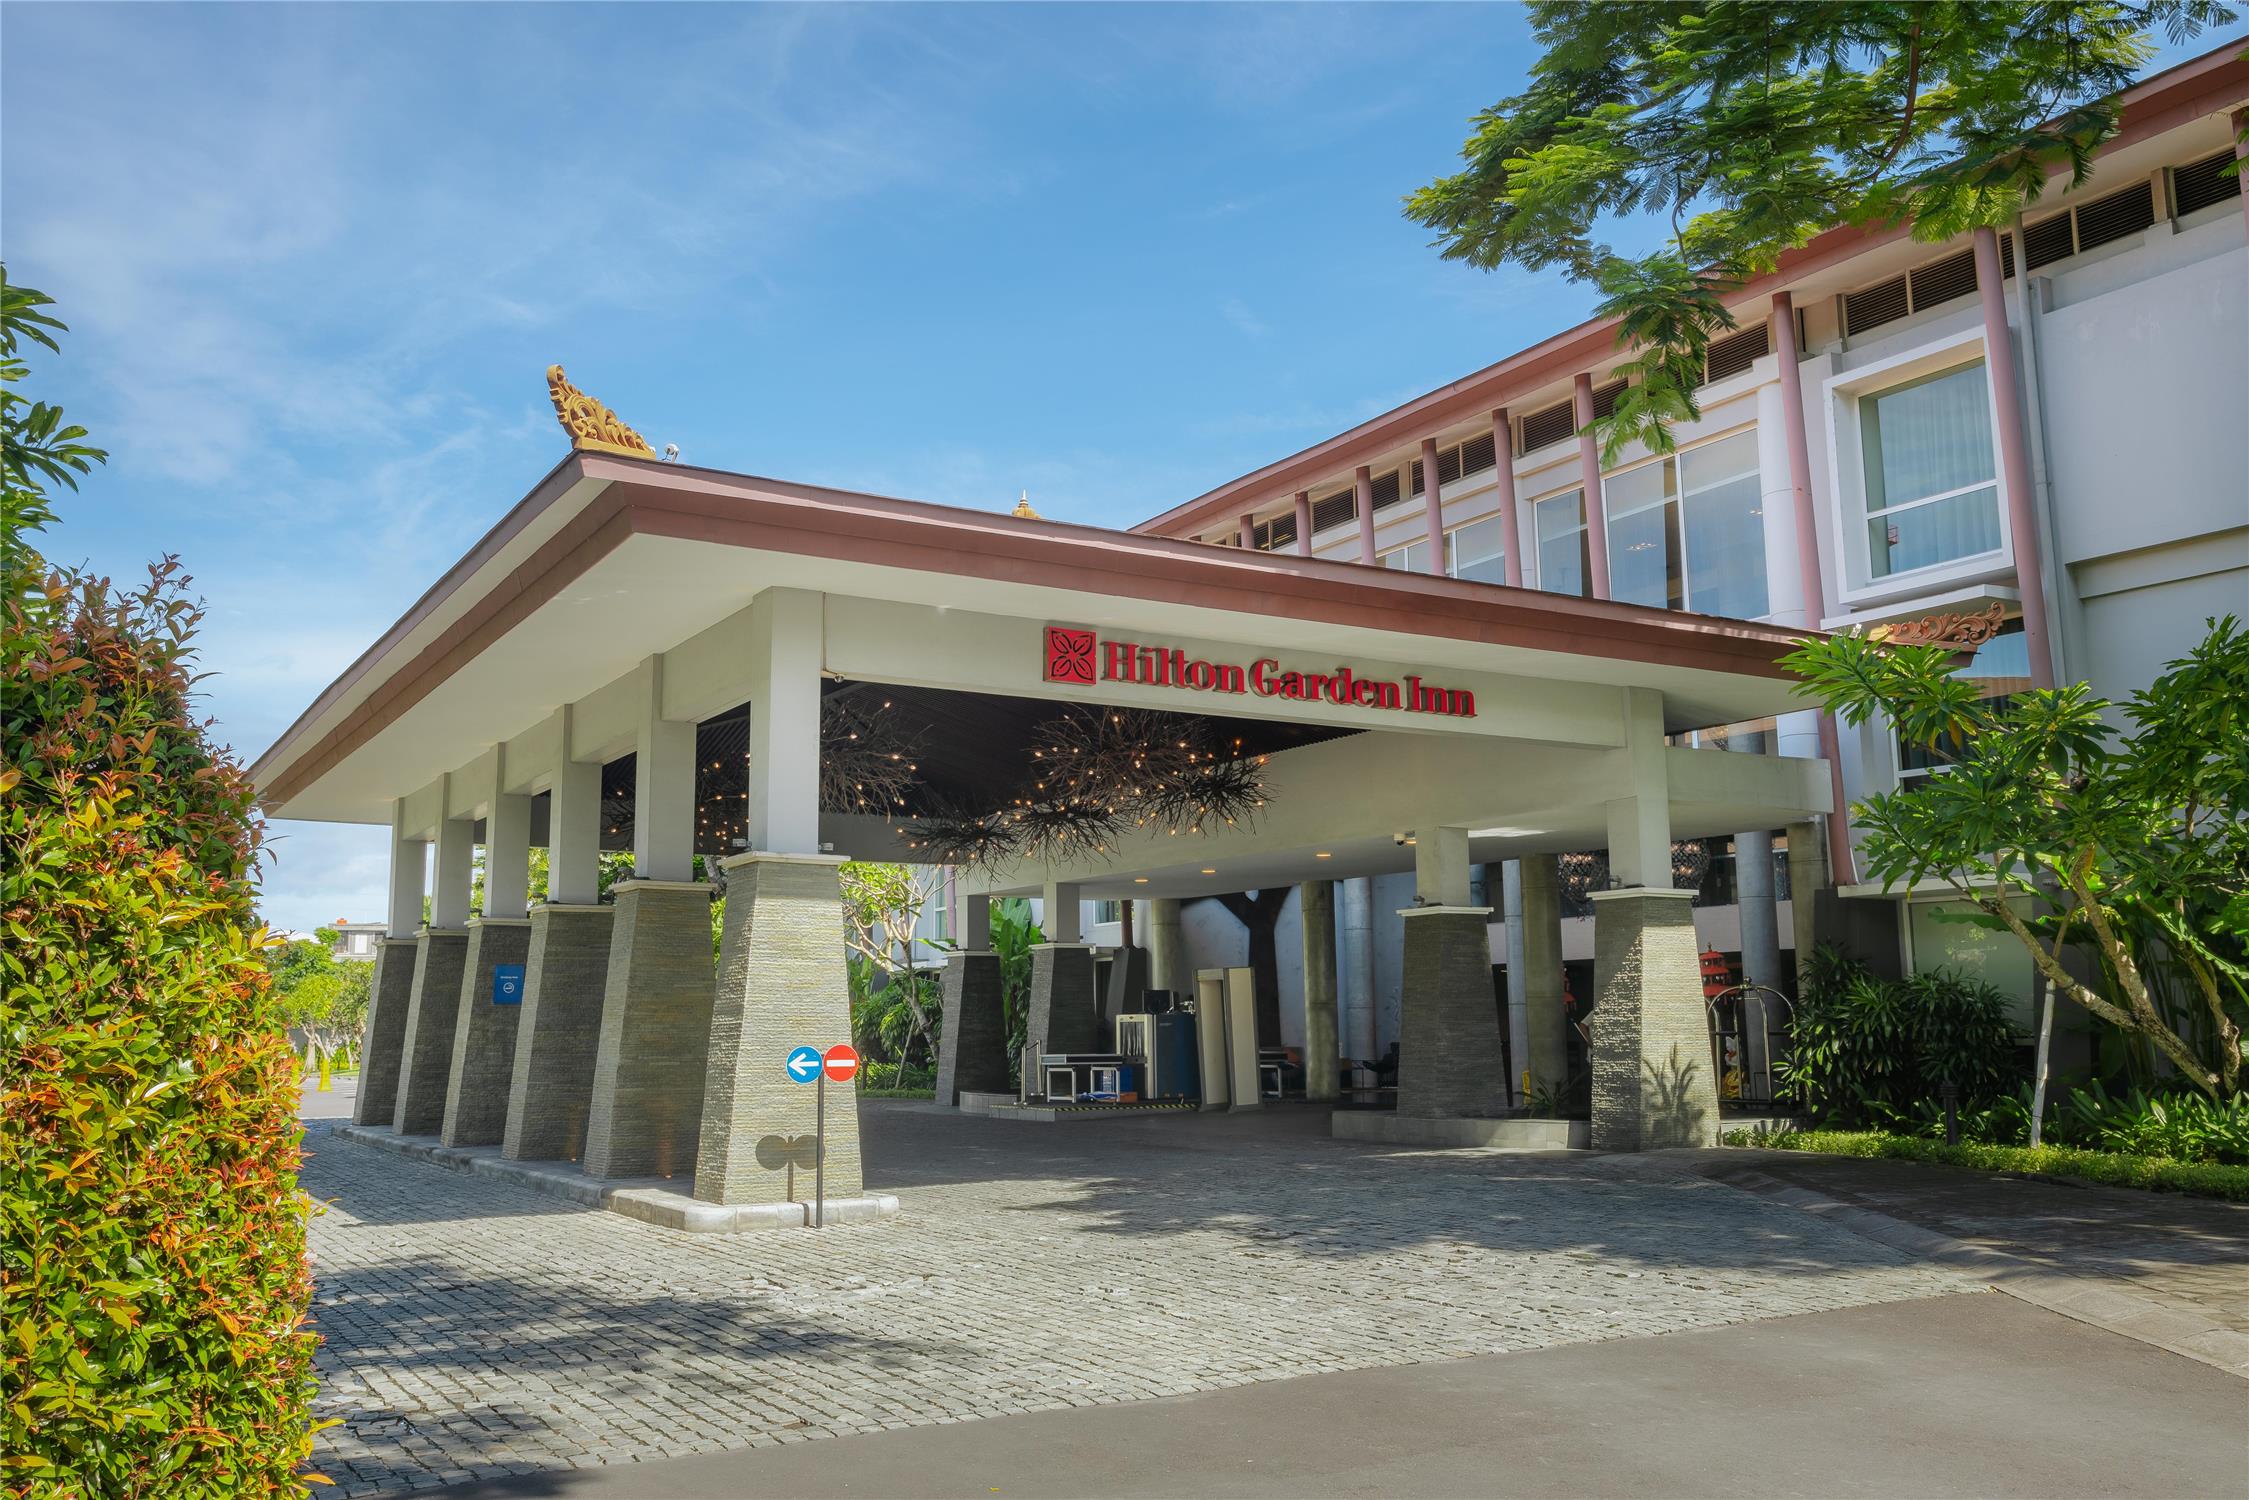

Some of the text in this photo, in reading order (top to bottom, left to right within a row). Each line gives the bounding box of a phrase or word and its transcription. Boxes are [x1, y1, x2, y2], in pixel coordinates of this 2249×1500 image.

[1101, 641, 1478, 718] Hilton Garden Inn
